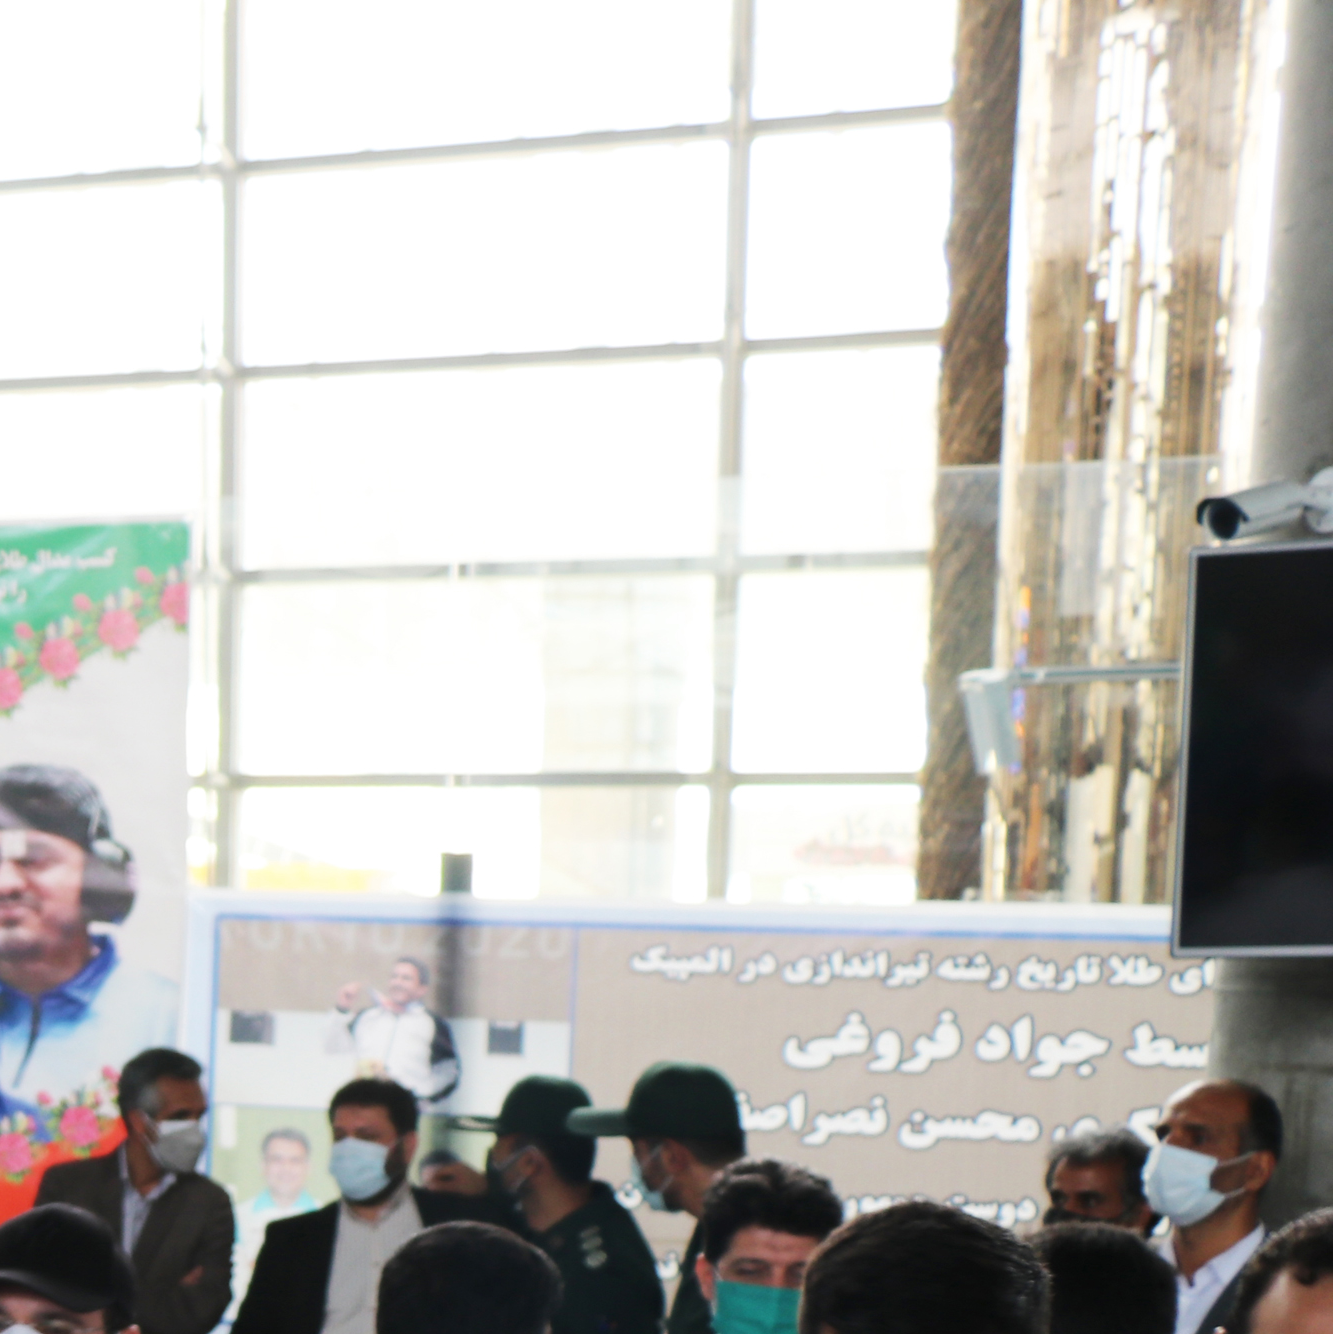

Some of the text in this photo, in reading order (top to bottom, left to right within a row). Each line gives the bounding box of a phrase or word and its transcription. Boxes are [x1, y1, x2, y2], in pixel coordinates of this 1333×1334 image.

[630, 944, 732, 981] المپیک
[737, 951, 777, 983] در
[935, 952, 1010, 991] رشته
[1016, 954, 1102, 992] تاریخ
[1107, 953, 1165, 987] طلا
[782, 1010, 962, 1074] فروغی
[975, 1013, 1112, 1079] جواد
[897, 1110, 1041, 1149] محسن
